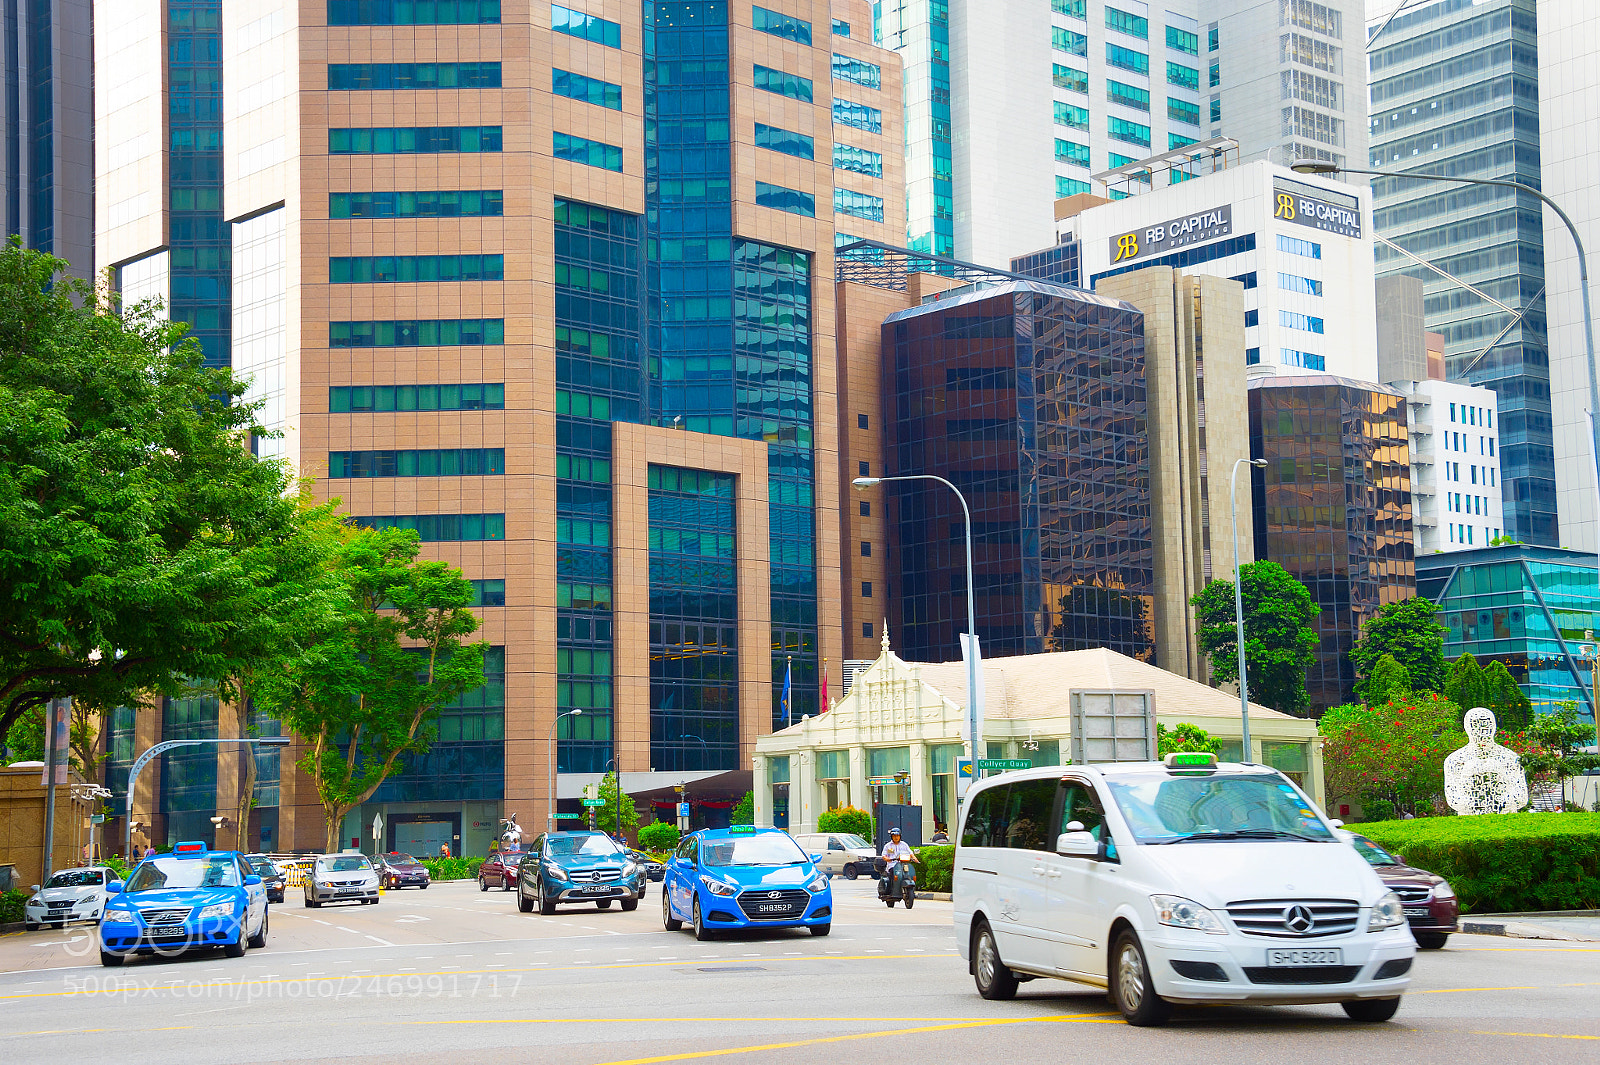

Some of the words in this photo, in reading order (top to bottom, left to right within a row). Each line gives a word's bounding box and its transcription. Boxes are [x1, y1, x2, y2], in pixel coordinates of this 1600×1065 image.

[1299, 199, 1315, 217] RB
[1316, 204, 1360, 229] CAPITAL
[1145, 226, 1165, 244] RB
[1169, 210, 1228, 237] CAPITAL
[1170, 226, 1228, 247] BUILDING
[1316, 221, 1361, 238] BUILDING
[979, 760, 1006, 768] Collyer
[1009, 760, 1028, 768] Quay
